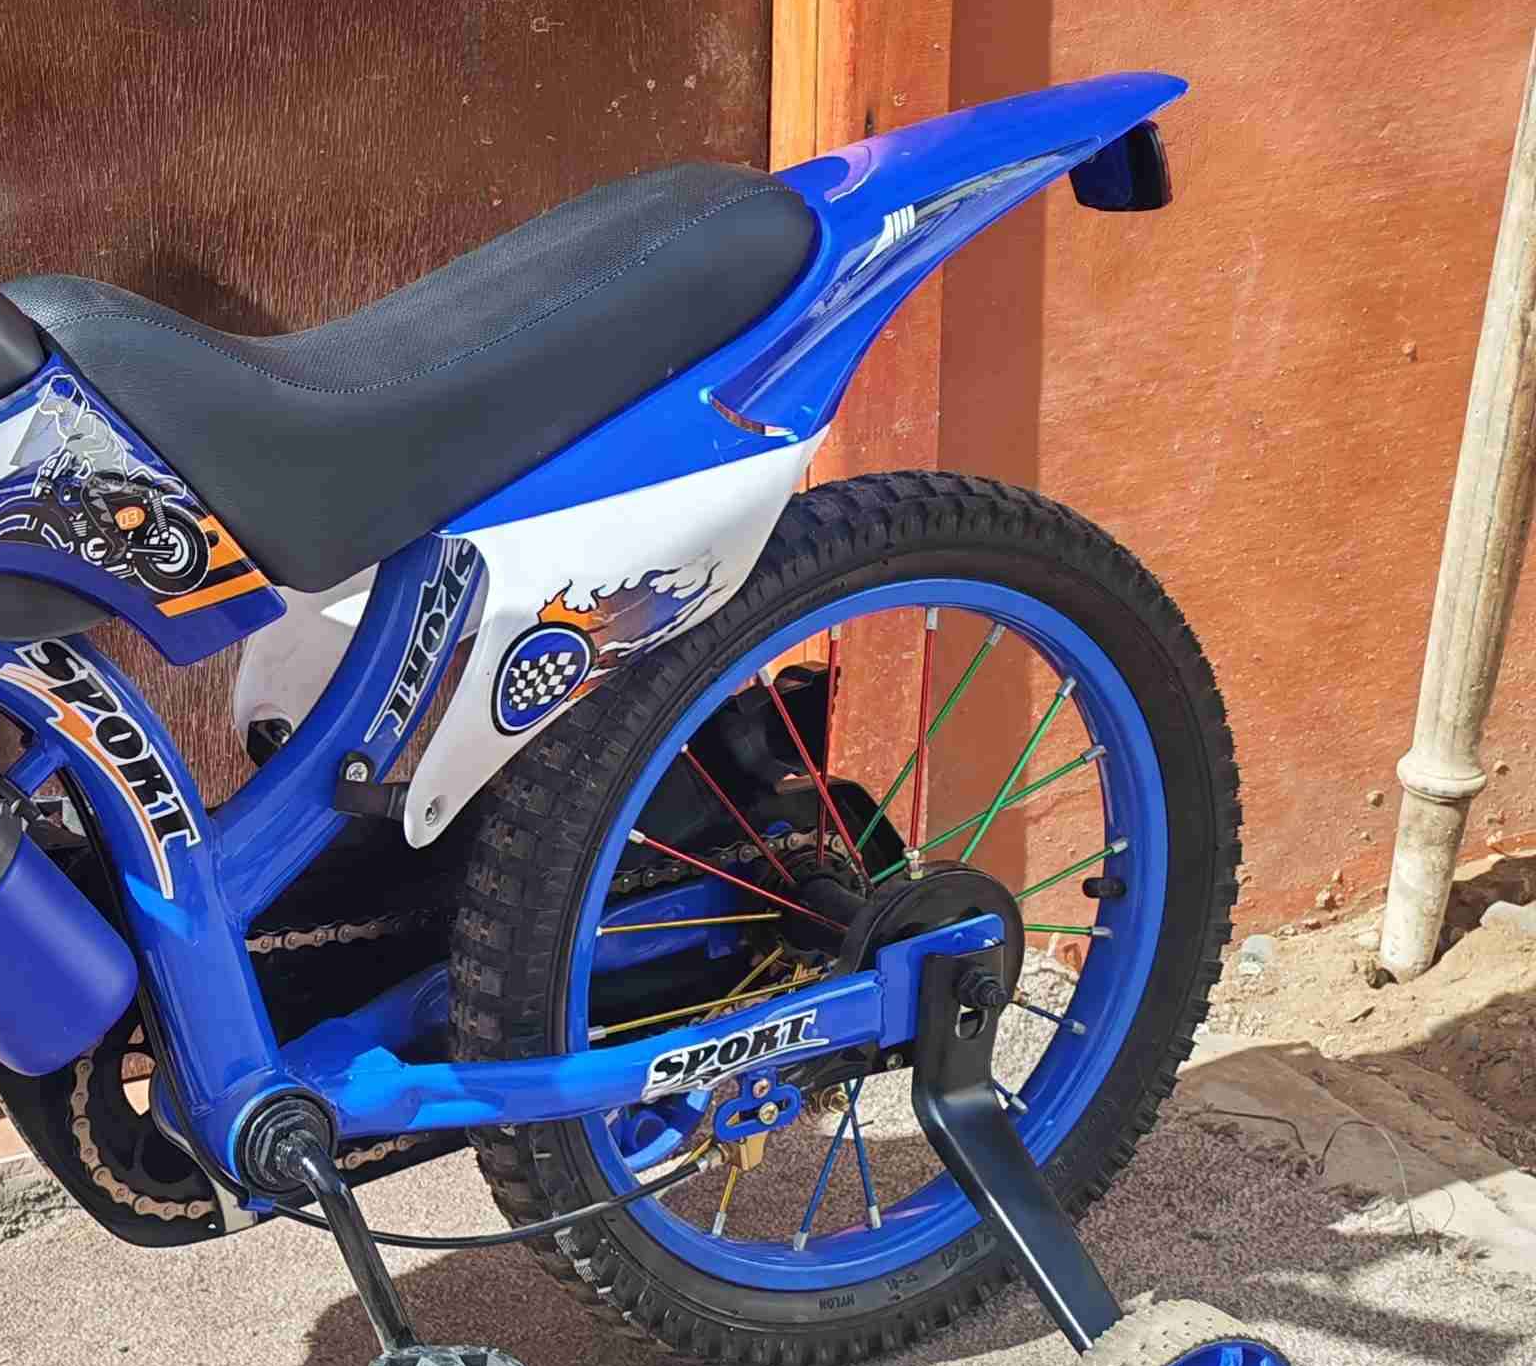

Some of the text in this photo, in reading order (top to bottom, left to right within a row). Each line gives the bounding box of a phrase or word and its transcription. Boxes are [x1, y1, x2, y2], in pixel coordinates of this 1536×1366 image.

[15, 637, 201, 848] SPORT
[649, 1009, 818, 1087] SPORT
[818, 1292, 856, 1311] NYLON
